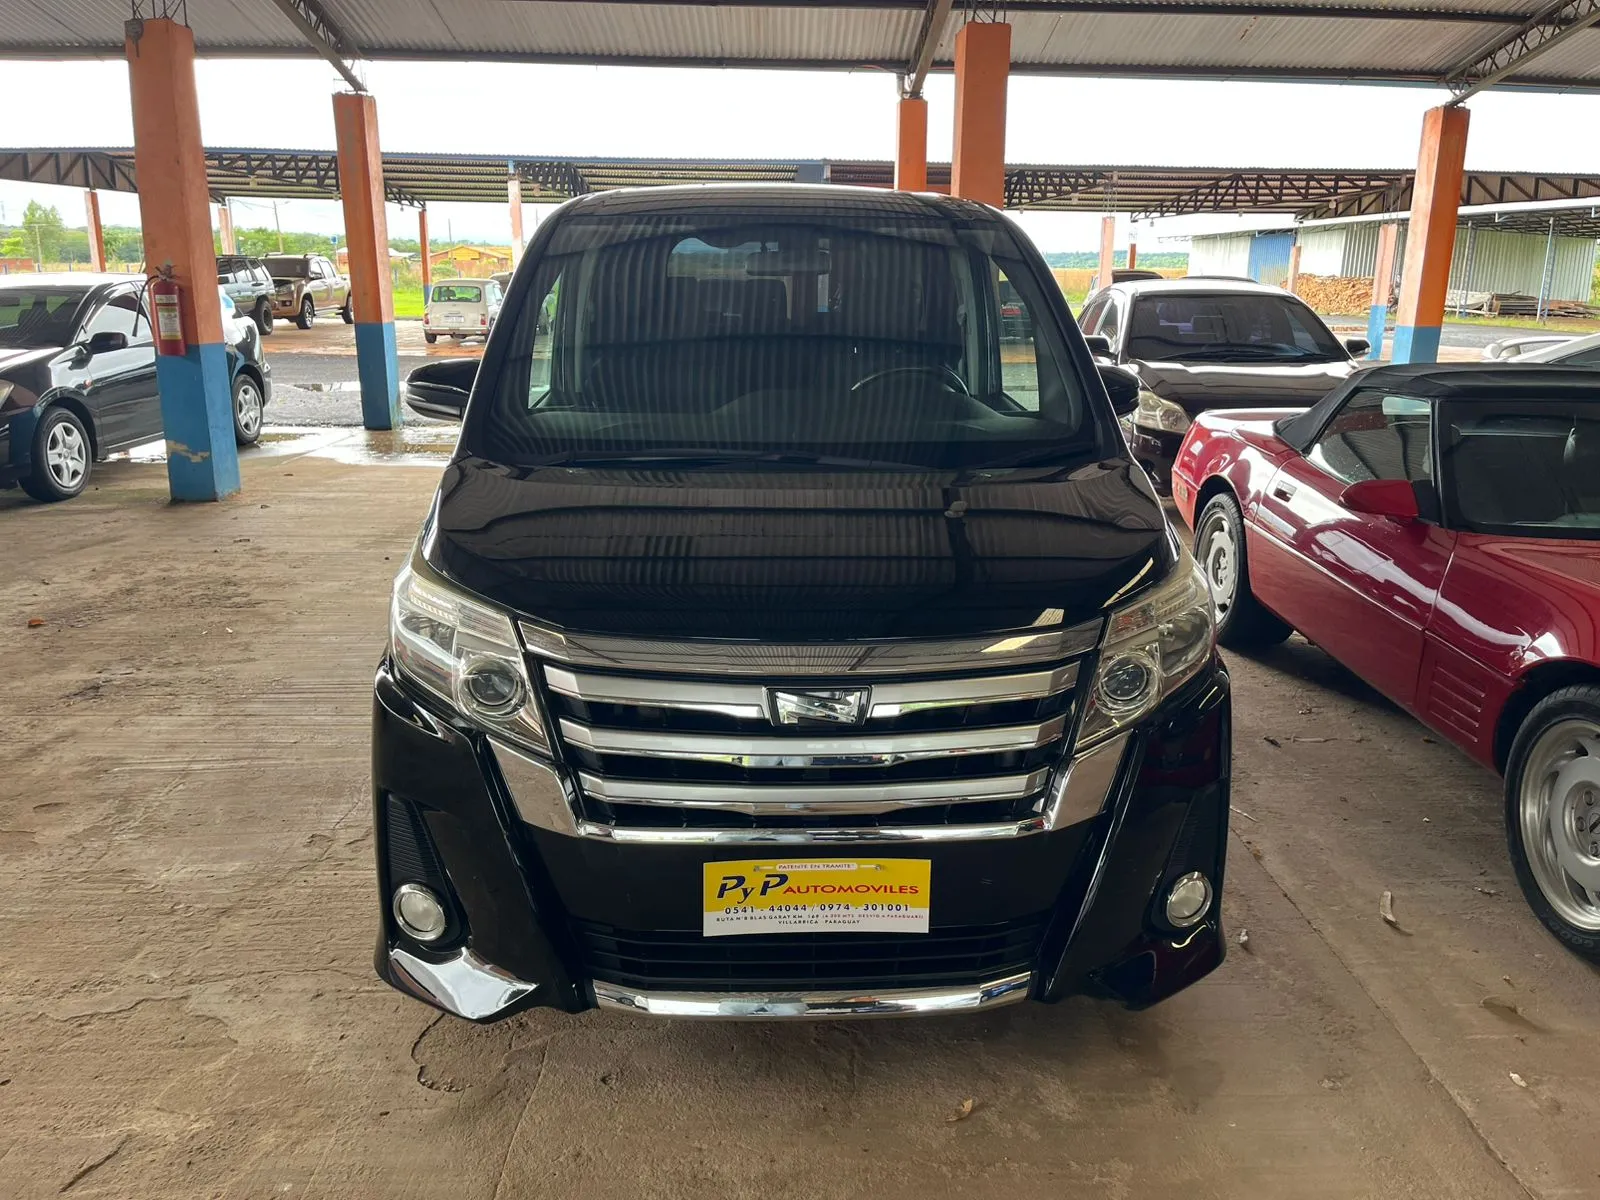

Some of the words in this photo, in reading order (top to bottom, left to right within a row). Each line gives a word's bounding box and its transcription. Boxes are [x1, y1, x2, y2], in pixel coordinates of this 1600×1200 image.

[782, 884, 920, 894] AUTOMOVILES
[724, 906, 754, 914] 0541
[768, 904, 807, 912] 44044
[863, 904, 909, 912] 301001
